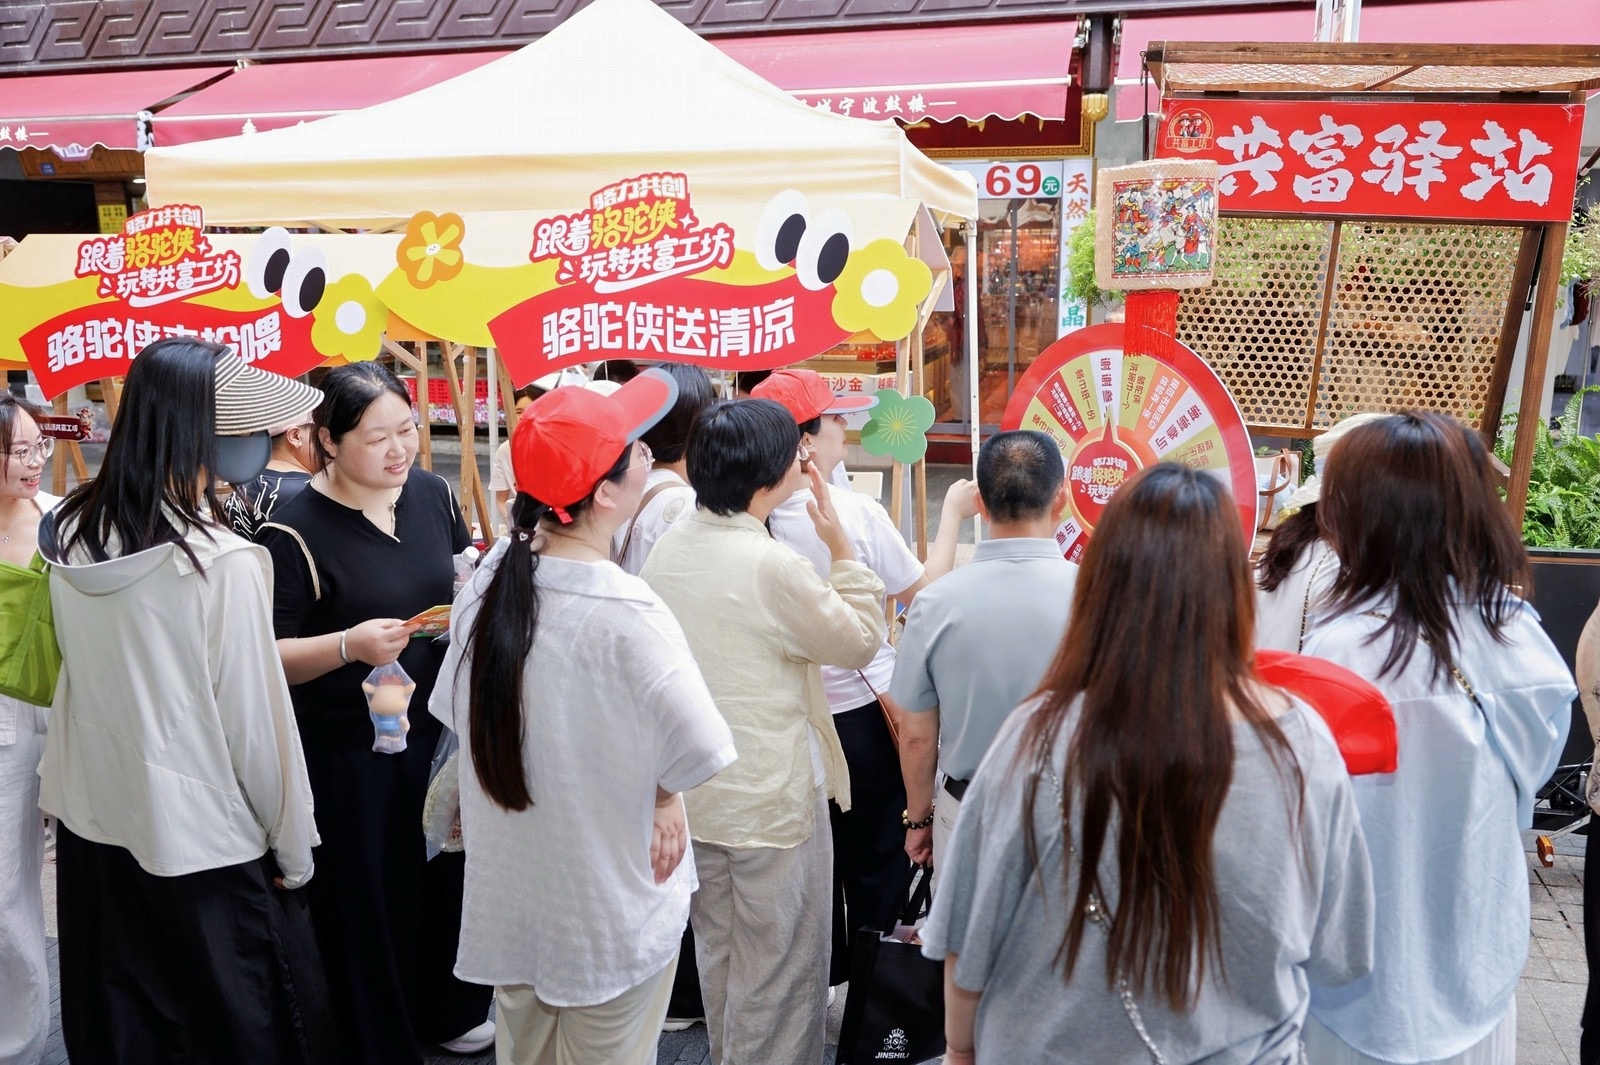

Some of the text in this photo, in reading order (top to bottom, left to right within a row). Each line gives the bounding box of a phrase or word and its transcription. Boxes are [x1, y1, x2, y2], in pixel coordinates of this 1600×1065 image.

[800, 93, 927, 117] 城宁波鼓楼
[1216, 113, 1553, 206] 共富驿站
[79, 228, 196, 275] 跟着骆驼侠
[534, 198, 679, 258] 跟着骆驼侠
[115, 250, 239, 295] 玩转共富工坊
[580, 230, 731, 281] 玩转共富工坊
[541, 295, 797, 361] 骆驼侠送清凉
